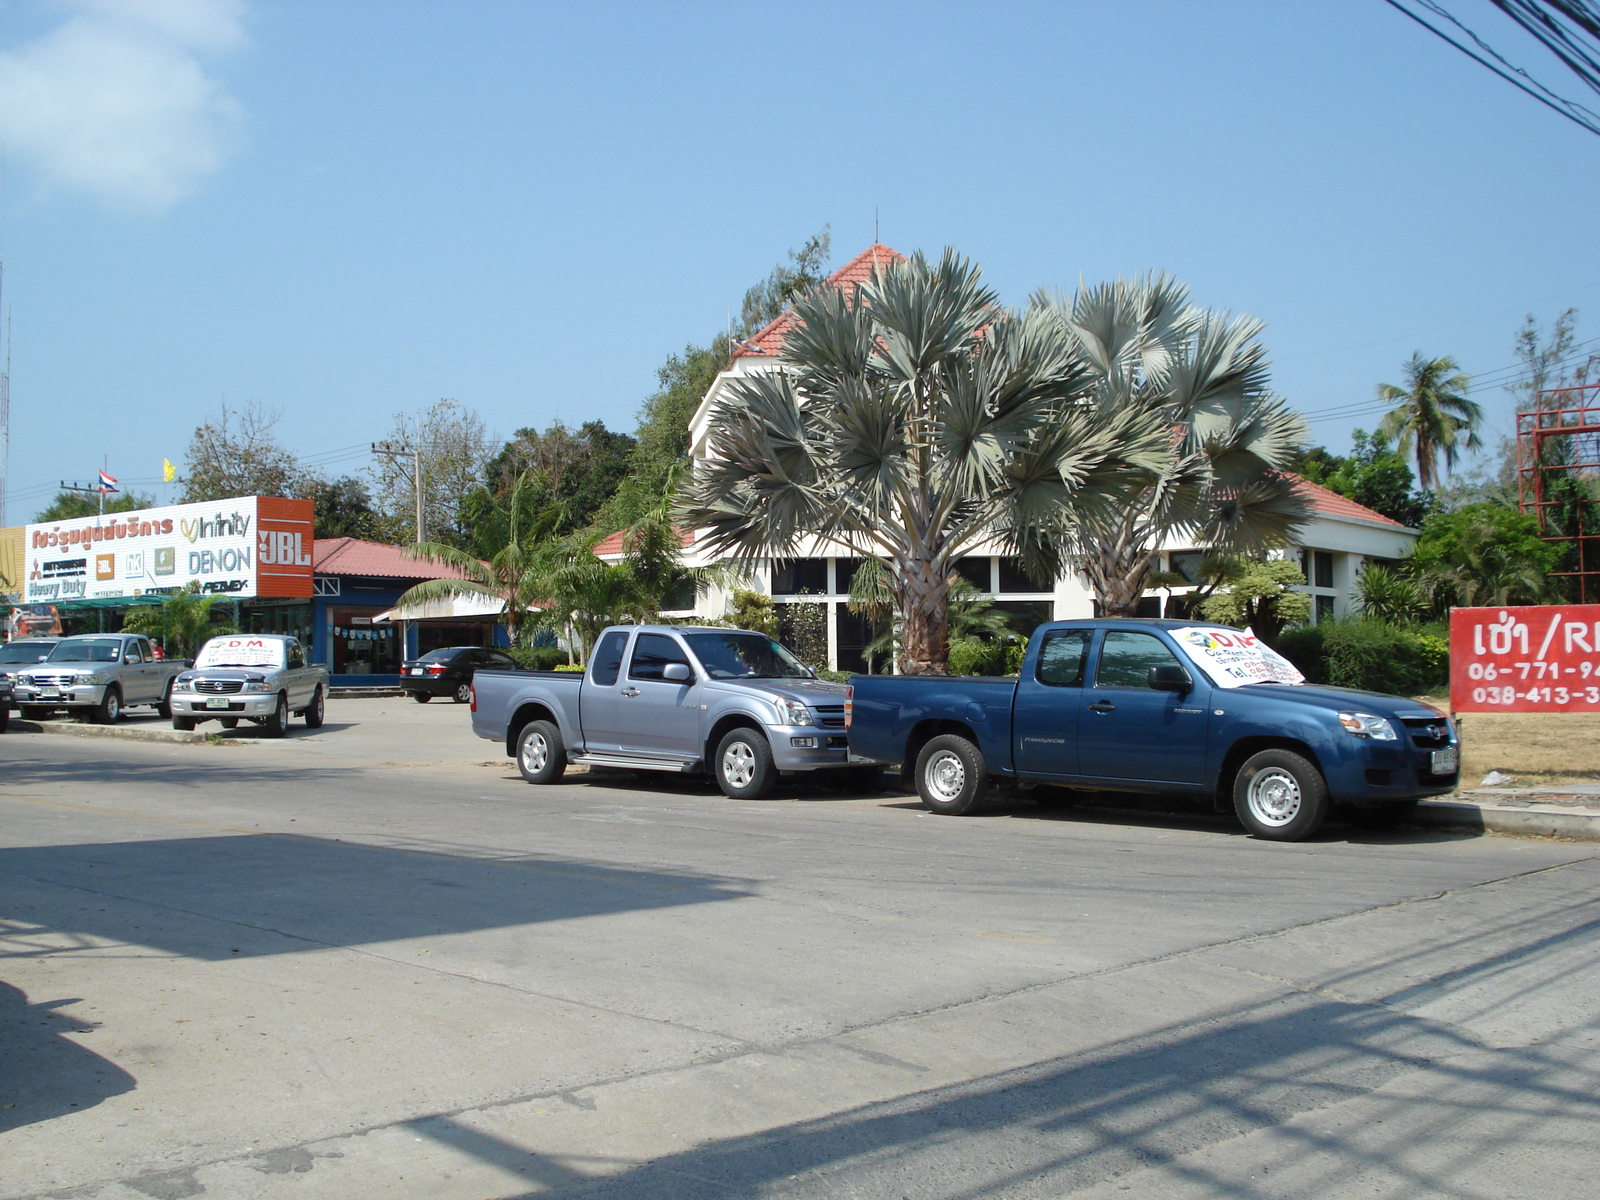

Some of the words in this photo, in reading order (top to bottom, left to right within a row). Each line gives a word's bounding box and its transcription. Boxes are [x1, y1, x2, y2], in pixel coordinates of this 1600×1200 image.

[199, 511, 251, 539] Infinity
[189, 547, 251, 575] DENON
[258, 530, 311, 566] JBL
[98, 559, 112, 574] JBL
[29, 582, 60, 600] Heavy
[61, 579, 87, 598] Duty
